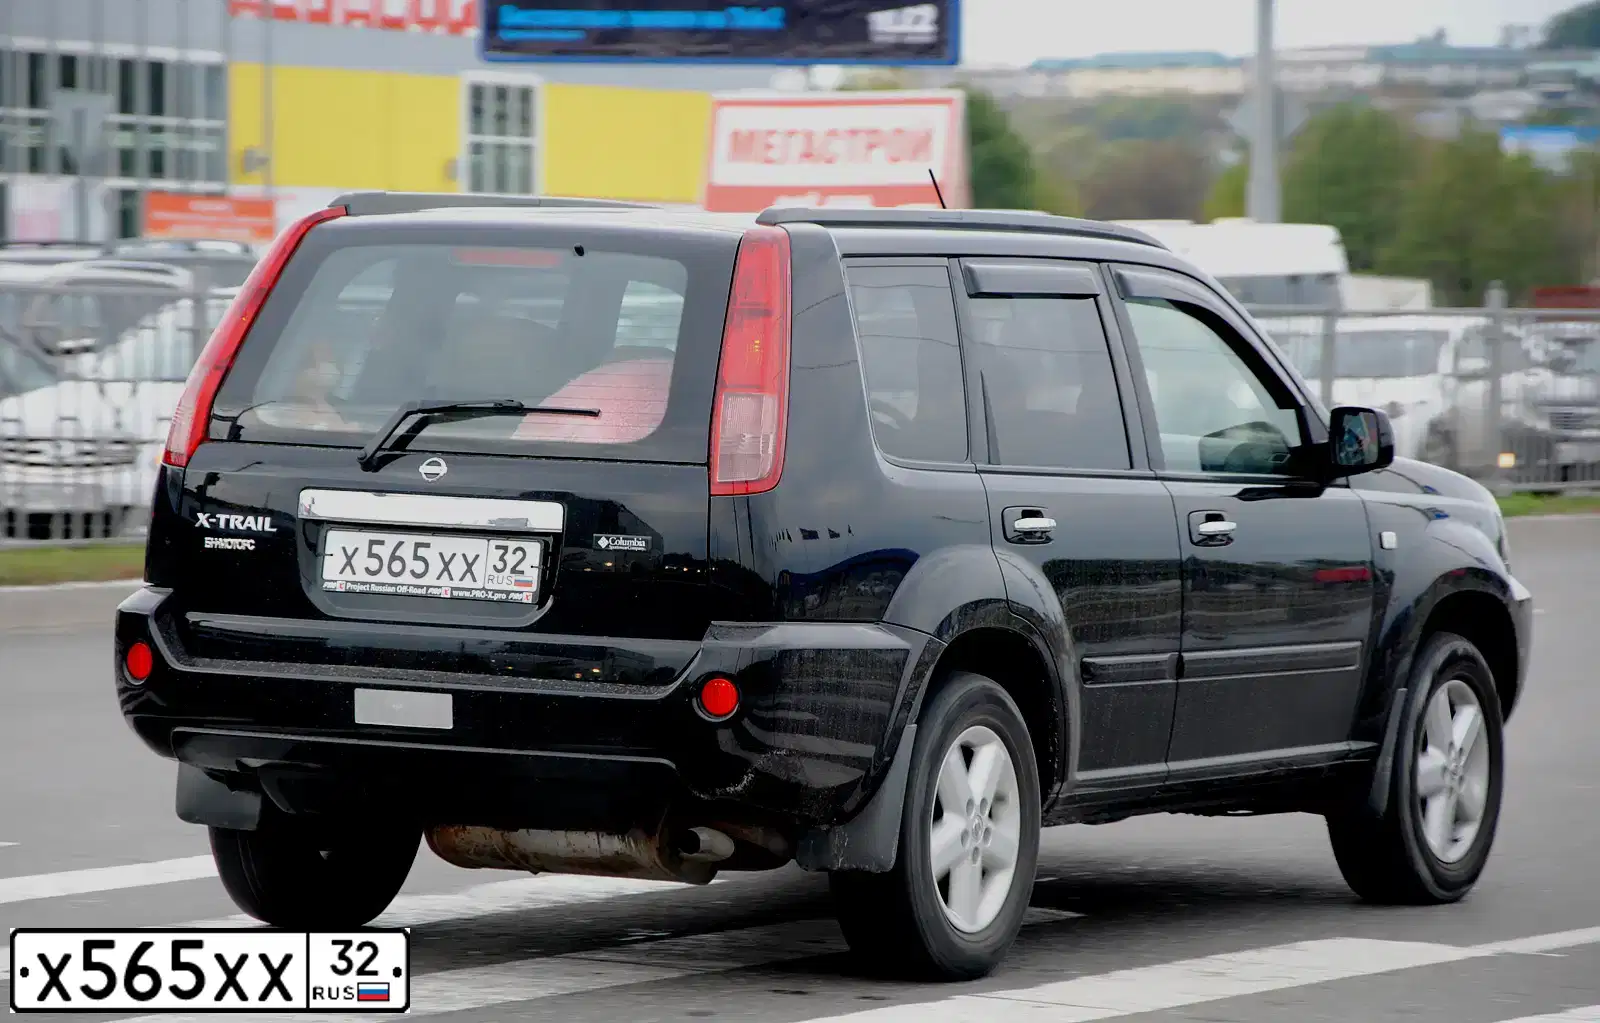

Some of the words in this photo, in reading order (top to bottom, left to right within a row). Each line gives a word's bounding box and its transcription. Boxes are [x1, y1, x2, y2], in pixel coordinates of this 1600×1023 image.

[195, 512, 278, 533] X-TRAIL
[608, 536, 646, 547] Columbia
[492, 545, 528, 575] 32
[487, 574, 513, 586] RUS
[346, 582, 370, 592] Project
[370, 583, 396, 593] Russian
[396, 585, 427, 595] Off-Road
[452, 589, 507, 601] www.PRO-X.pro
